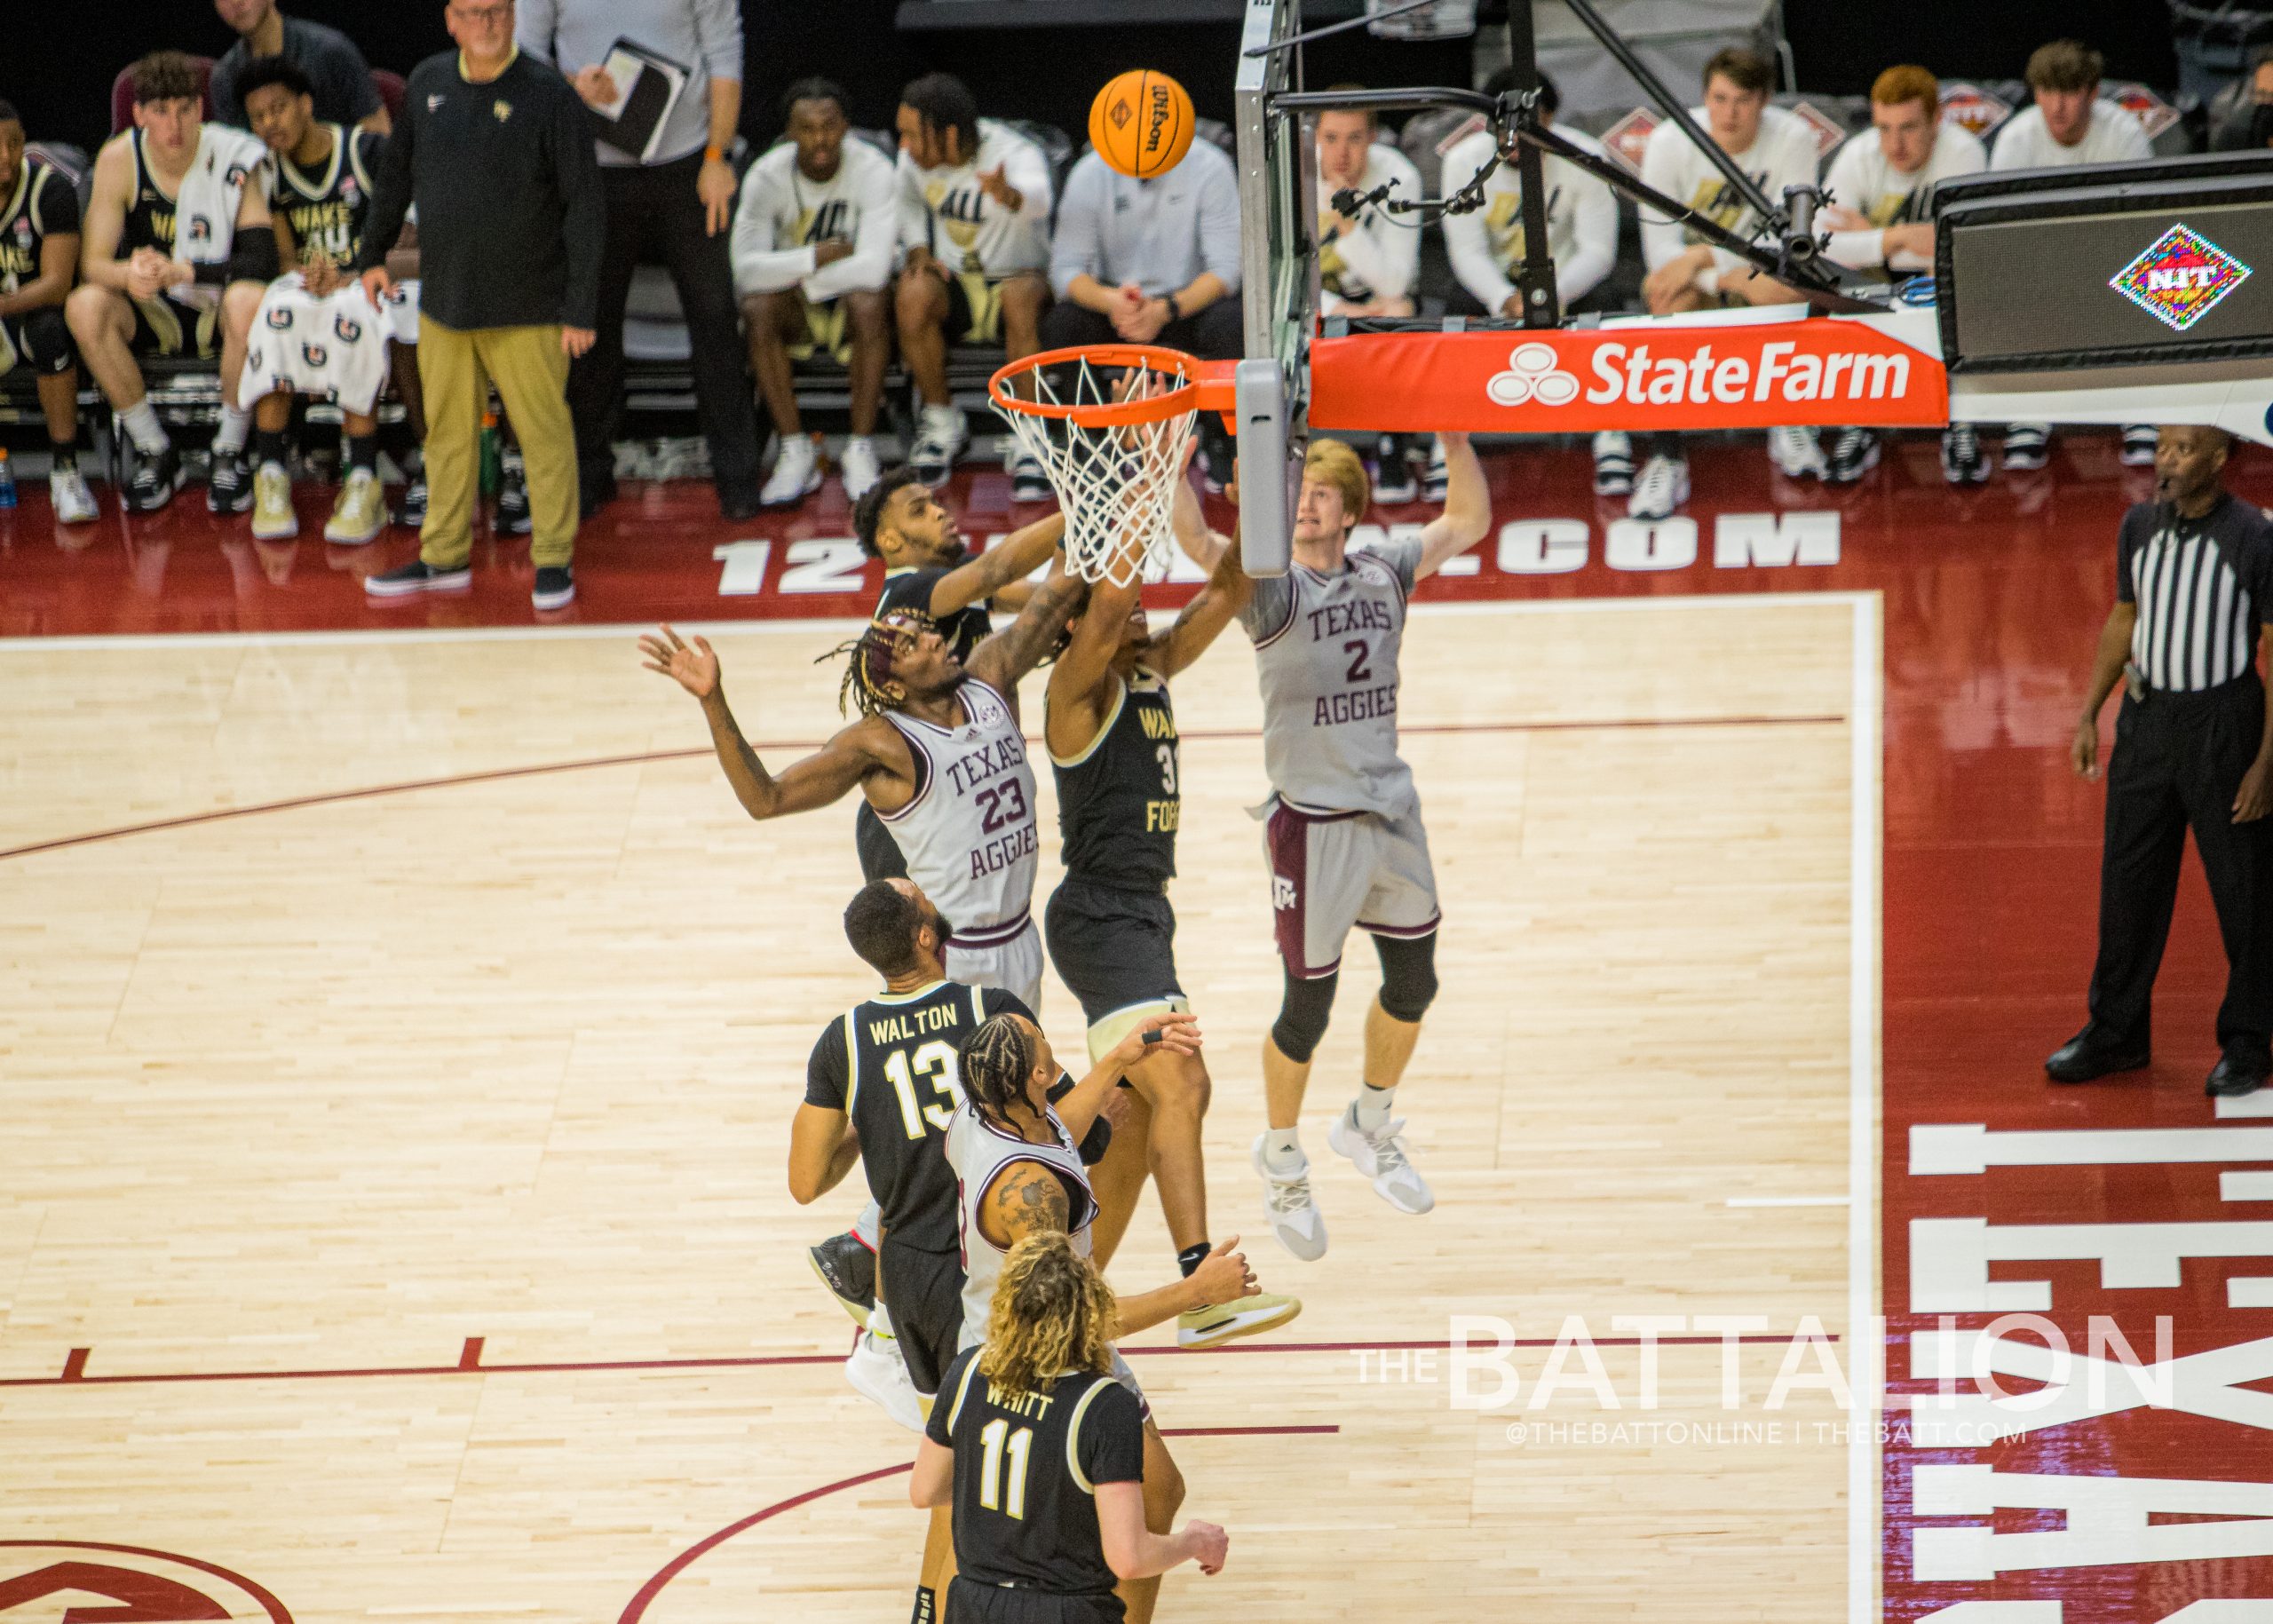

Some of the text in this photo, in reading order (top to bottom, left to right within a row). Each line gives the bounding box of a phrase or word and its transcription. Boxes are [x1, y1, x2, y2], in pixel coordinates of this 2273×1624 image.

[1145, 85, 1169, 153] Wilson
[2149, 265, 2218, 291] NIT
[1307, 598, 1393, 642] TEXAS
[1343, 638, 1372, 684] 2
[946, 736, 1023, 797] TEXAS
[975, 775, 1026, 836] 23
[869, 1002, 957, 1046] WALTON
[884, 1039, 967, 1140] 13
[980, 1417, 1034, 1521] 11
